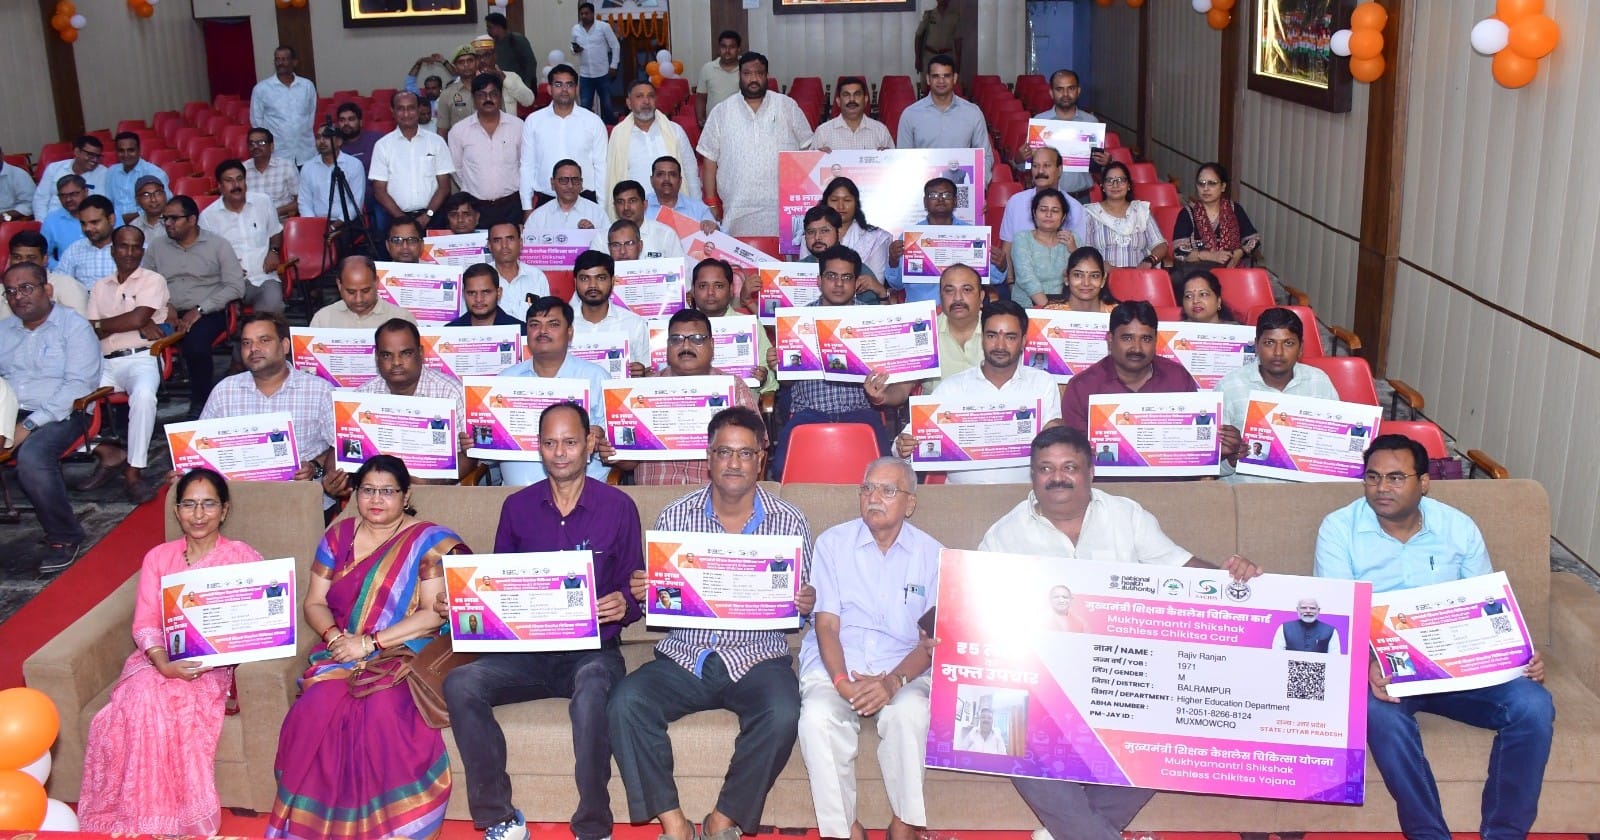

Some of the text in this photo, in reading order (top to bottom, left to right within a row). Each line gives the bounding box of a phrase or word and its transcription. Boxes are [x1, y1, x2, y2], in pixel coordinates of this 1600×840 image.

[1107, 615, 1245, 634] Mukhyamantri Shikshak
[1106, 624, 1238, 644] Cashless Chikitsa Card
[1120, 647, 1149, 656] NAME
[1178, 650, 1227, 662] Rajiv Ranjan
[1178, 662, 1196, 671] 1971
[1114, 669, 1144, 677] GENDER
[1116, 680, 1150, 688] DISTRICT
[1178, 684, 1232, 695] BALRAMPUR
[1120, 692, 1170, 701] DEPARTMENT
[1113, 702, 1146, 710] NUMBER
[1177, 696, 1290, 712] Higher Education Department
[1176, 706, 1252, 720] 91-2051-8266-8124
[1174, 742, 1208, 757] शिक्षक
[1253, 750, 1296, 764] चिकित्सा
[1300, 755, 1334, 767] योजना
[1164, 756, 1294, 774] Mukhyamantri Shikshak
[1160, 768, 1296, 788] Cashless Chikitsa Yojana
